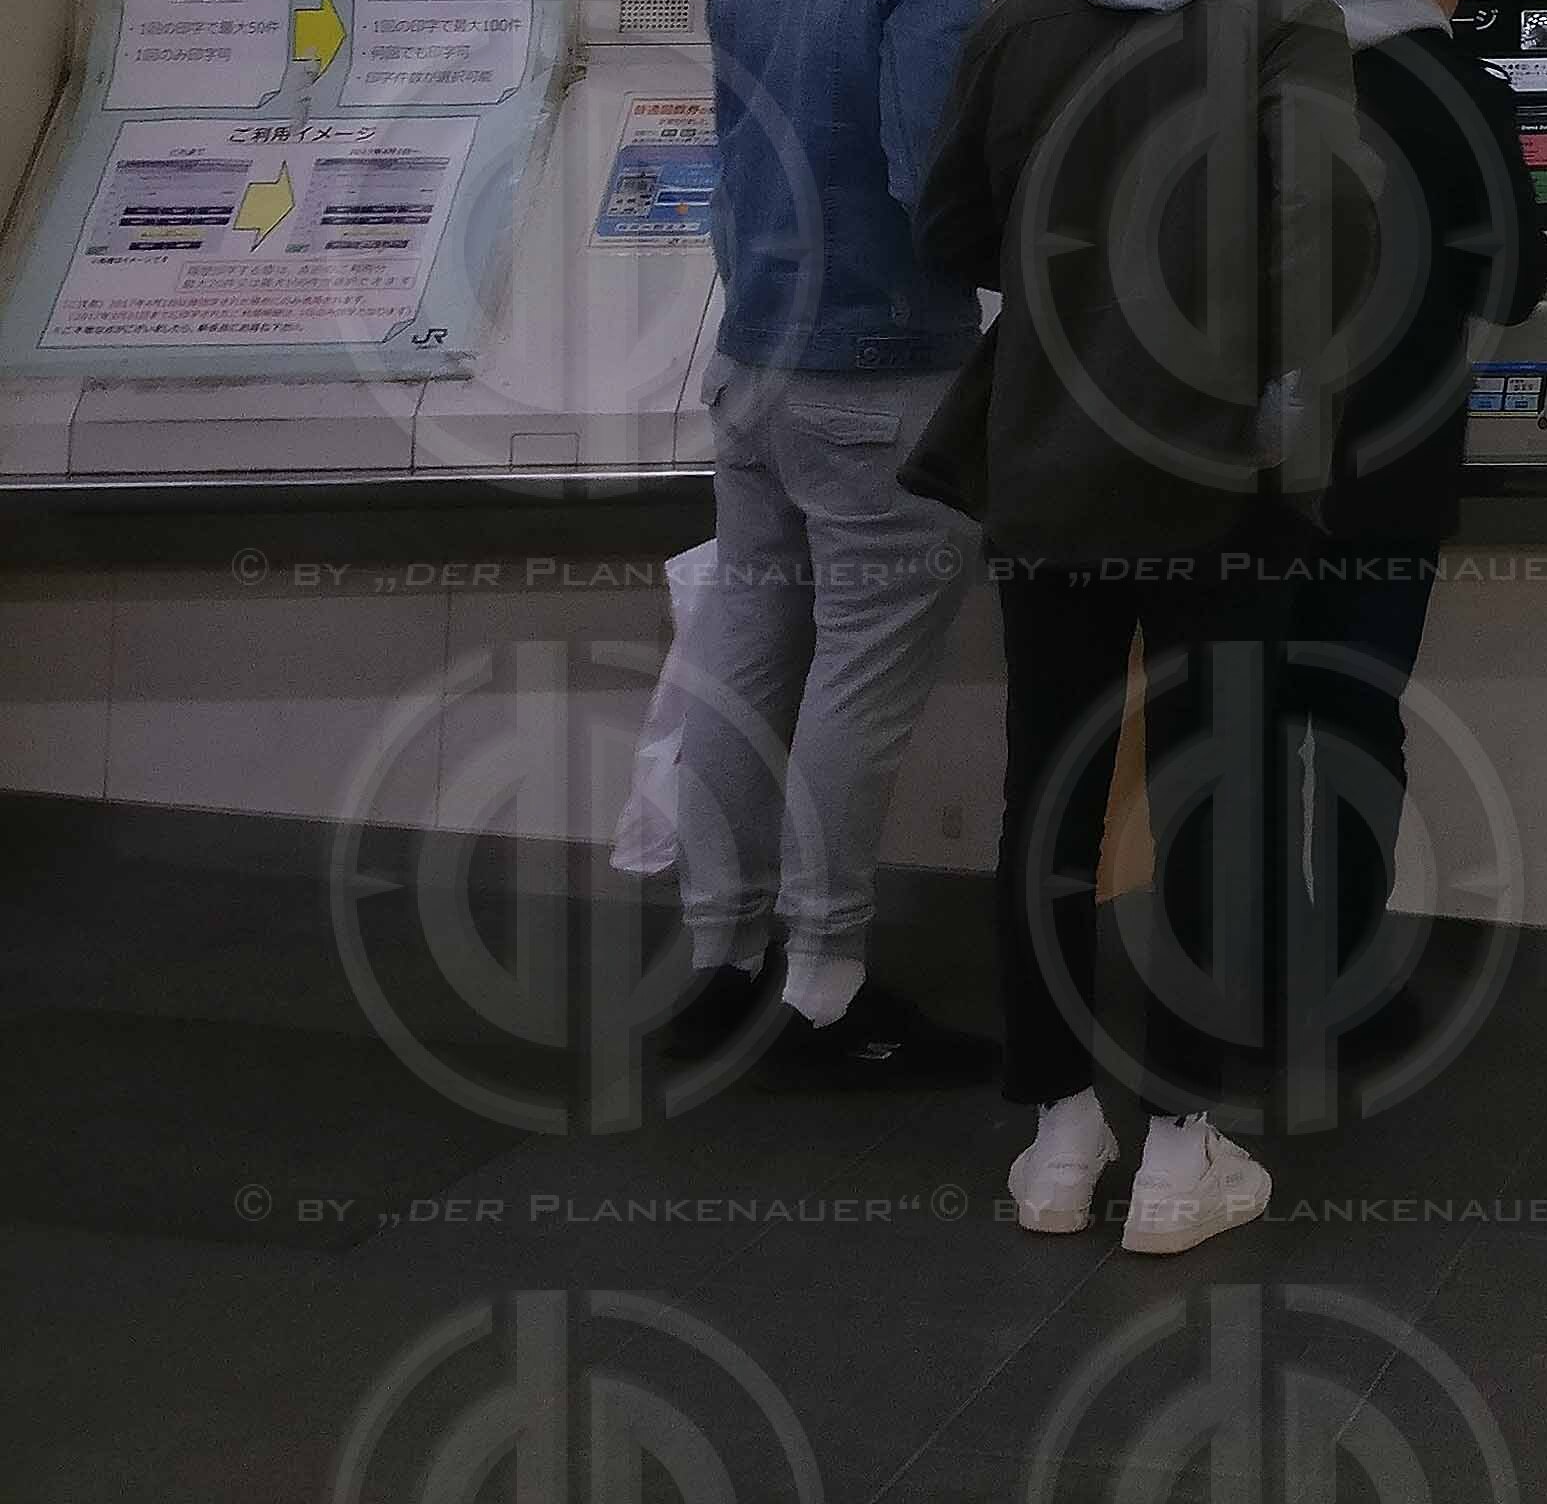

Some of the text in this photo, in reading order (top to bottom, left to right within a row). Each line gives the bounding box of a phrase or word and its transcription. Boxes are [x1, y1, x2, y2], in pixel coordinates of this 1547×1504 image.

[229, 126, 376, 144] ご利用イメージ
